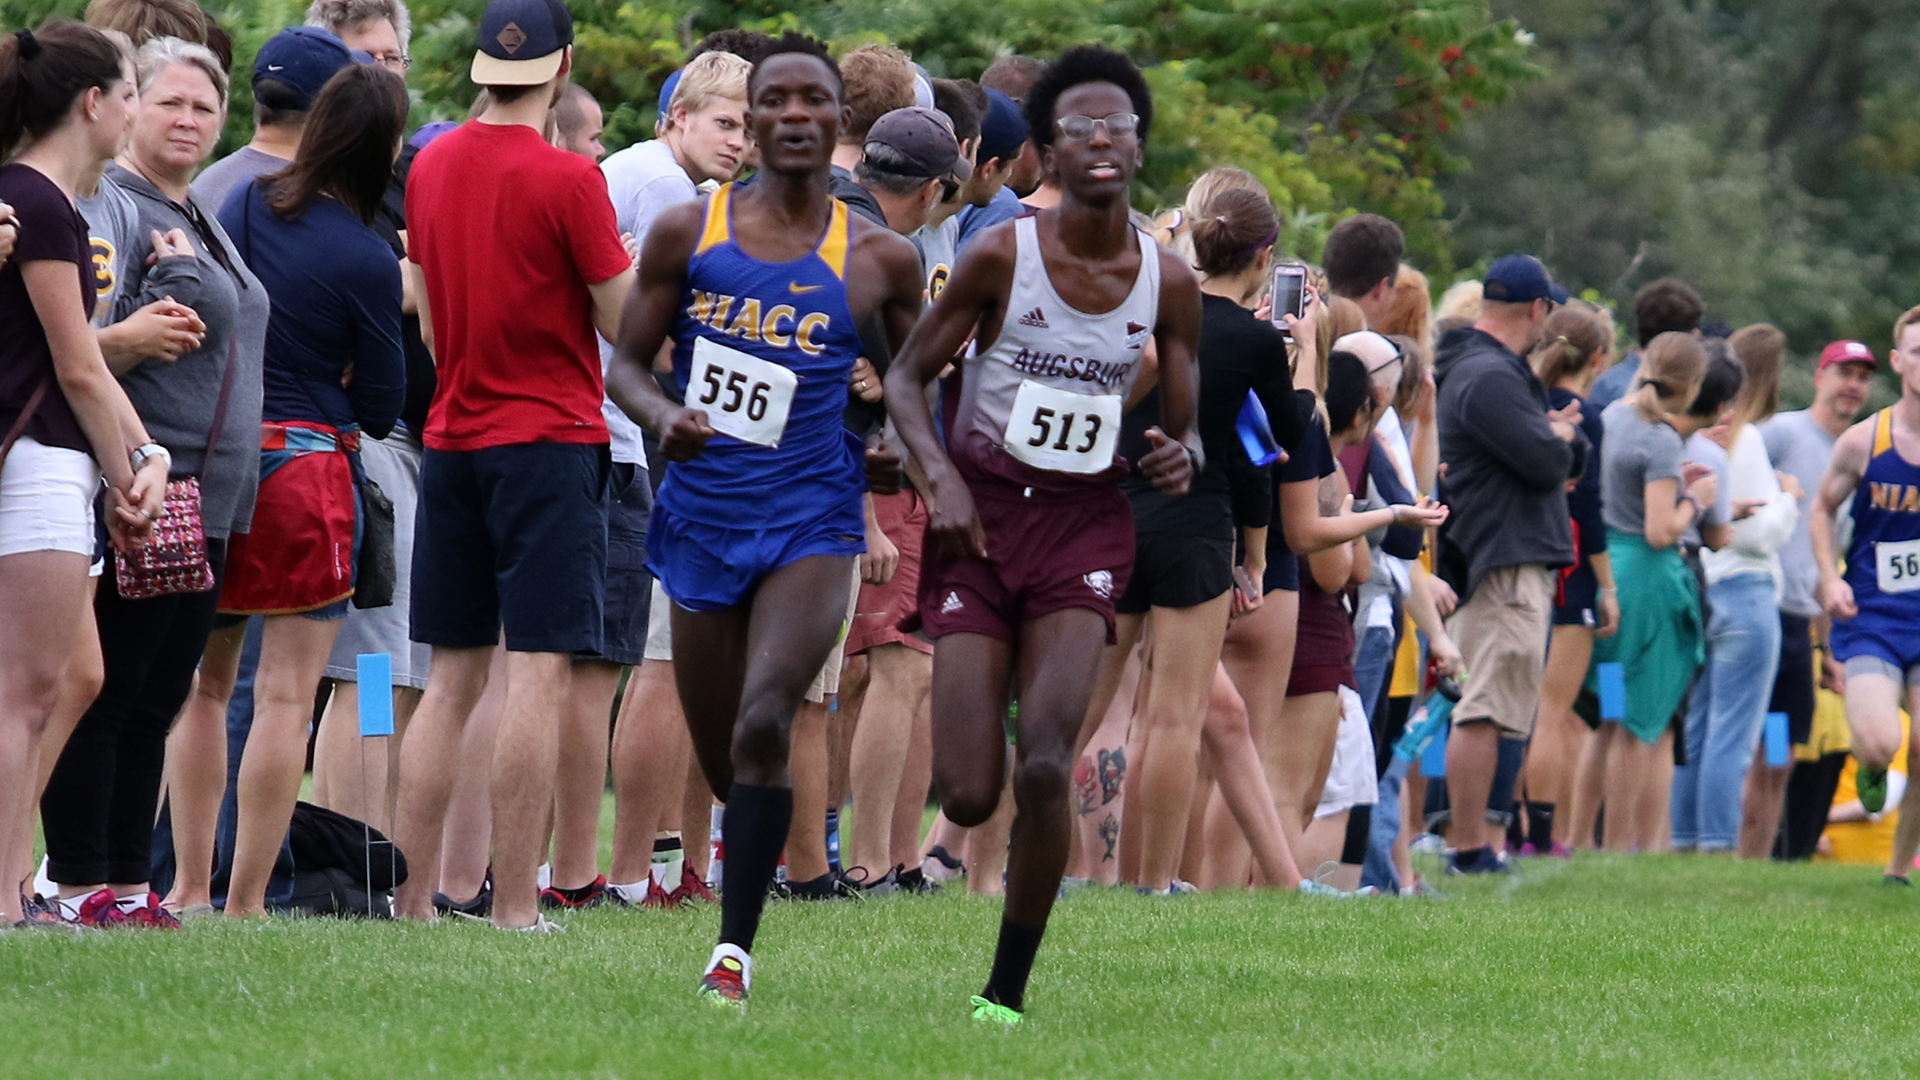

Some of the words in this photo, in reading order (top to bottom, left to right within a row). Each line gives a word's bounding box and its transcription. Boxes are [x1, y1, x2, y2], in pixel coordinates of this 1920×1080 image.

[686, 288, 830, 355] NIACC
[1018, 317, 1049, 329] adidas
[699, 362, 771, 421] 556
[1027, 406, 1102, 453] 513
[1870, 481, 1920, 512] NIA
[1890, 553, 1919, 580] 56
